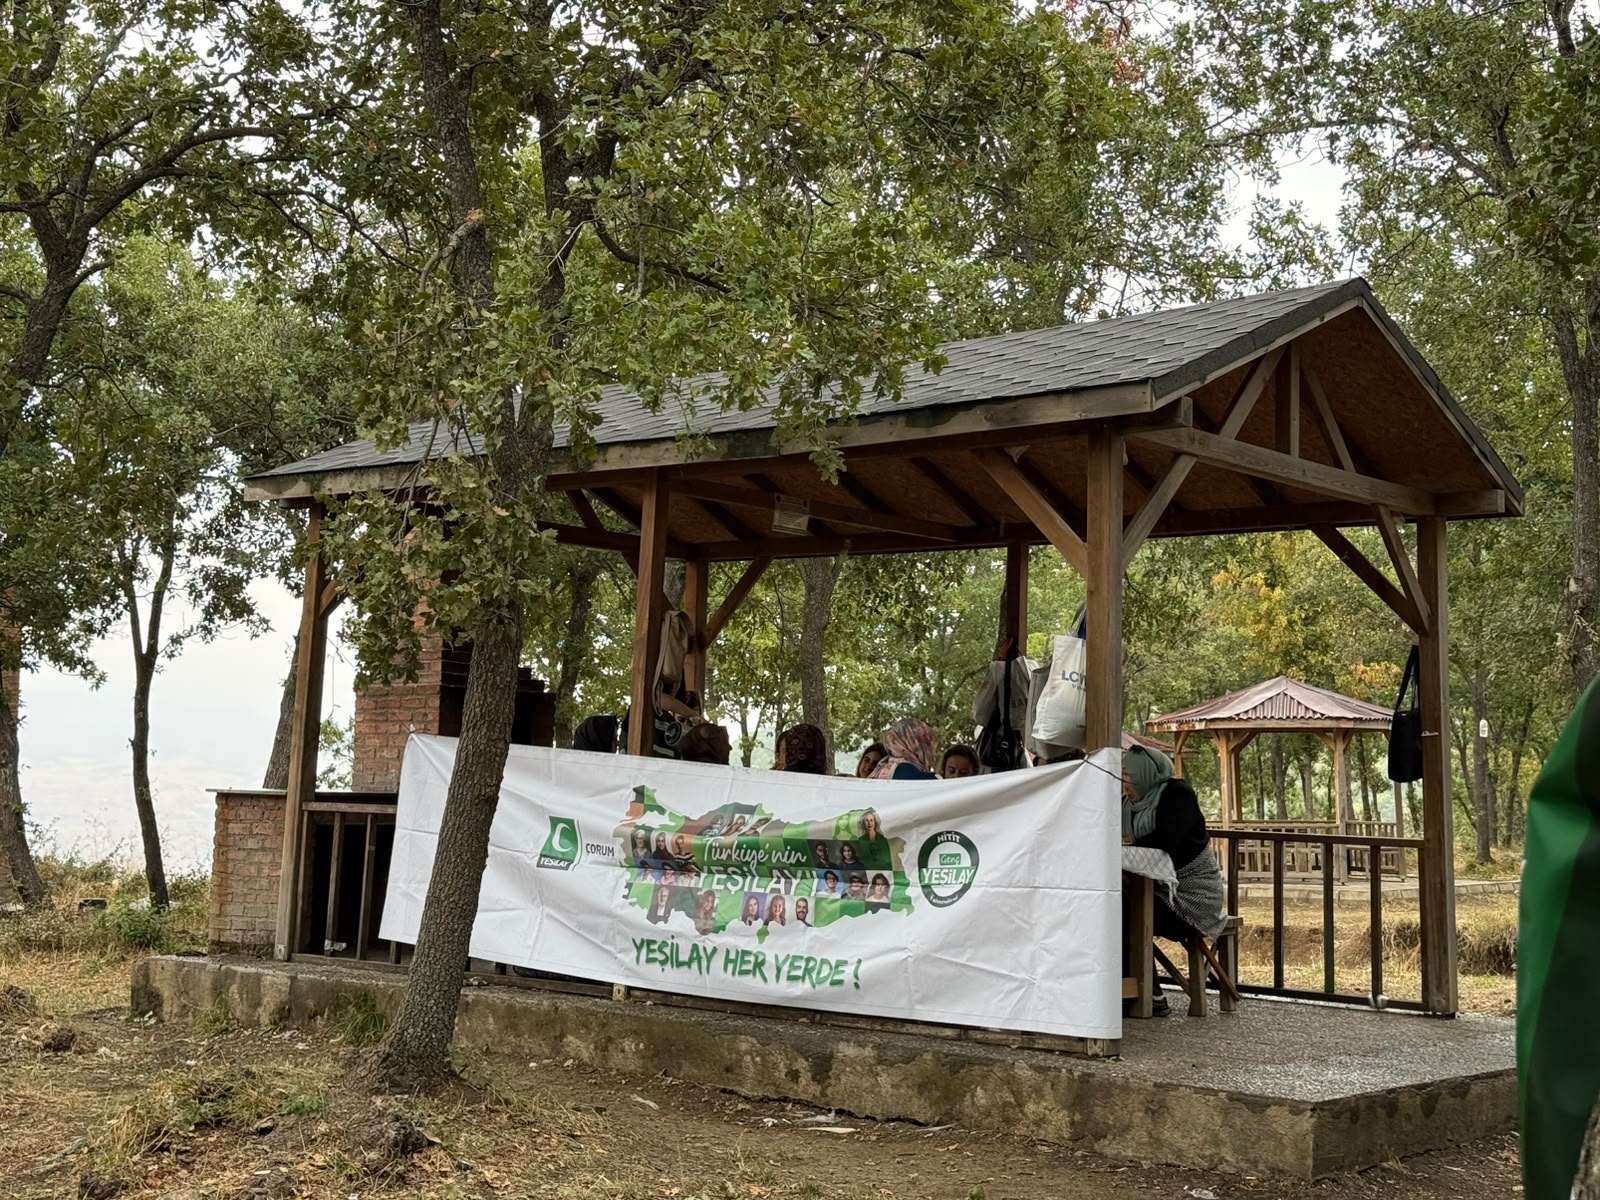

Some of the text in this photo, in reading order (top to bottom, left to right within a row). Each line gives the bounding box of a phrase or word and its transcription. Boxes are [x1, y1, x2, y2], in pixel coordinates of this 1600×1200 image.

[585, 843, 615, 857] ÇORUM
[703, 836, 807, 877] Türkiye'nin
[922, 868, 976, 887] YEŞİLAY
[631, 934, 718, 976] YEŞİLAY
[722, 947, 768, 984] HER
[774, 953, 849, 989] YERDE
